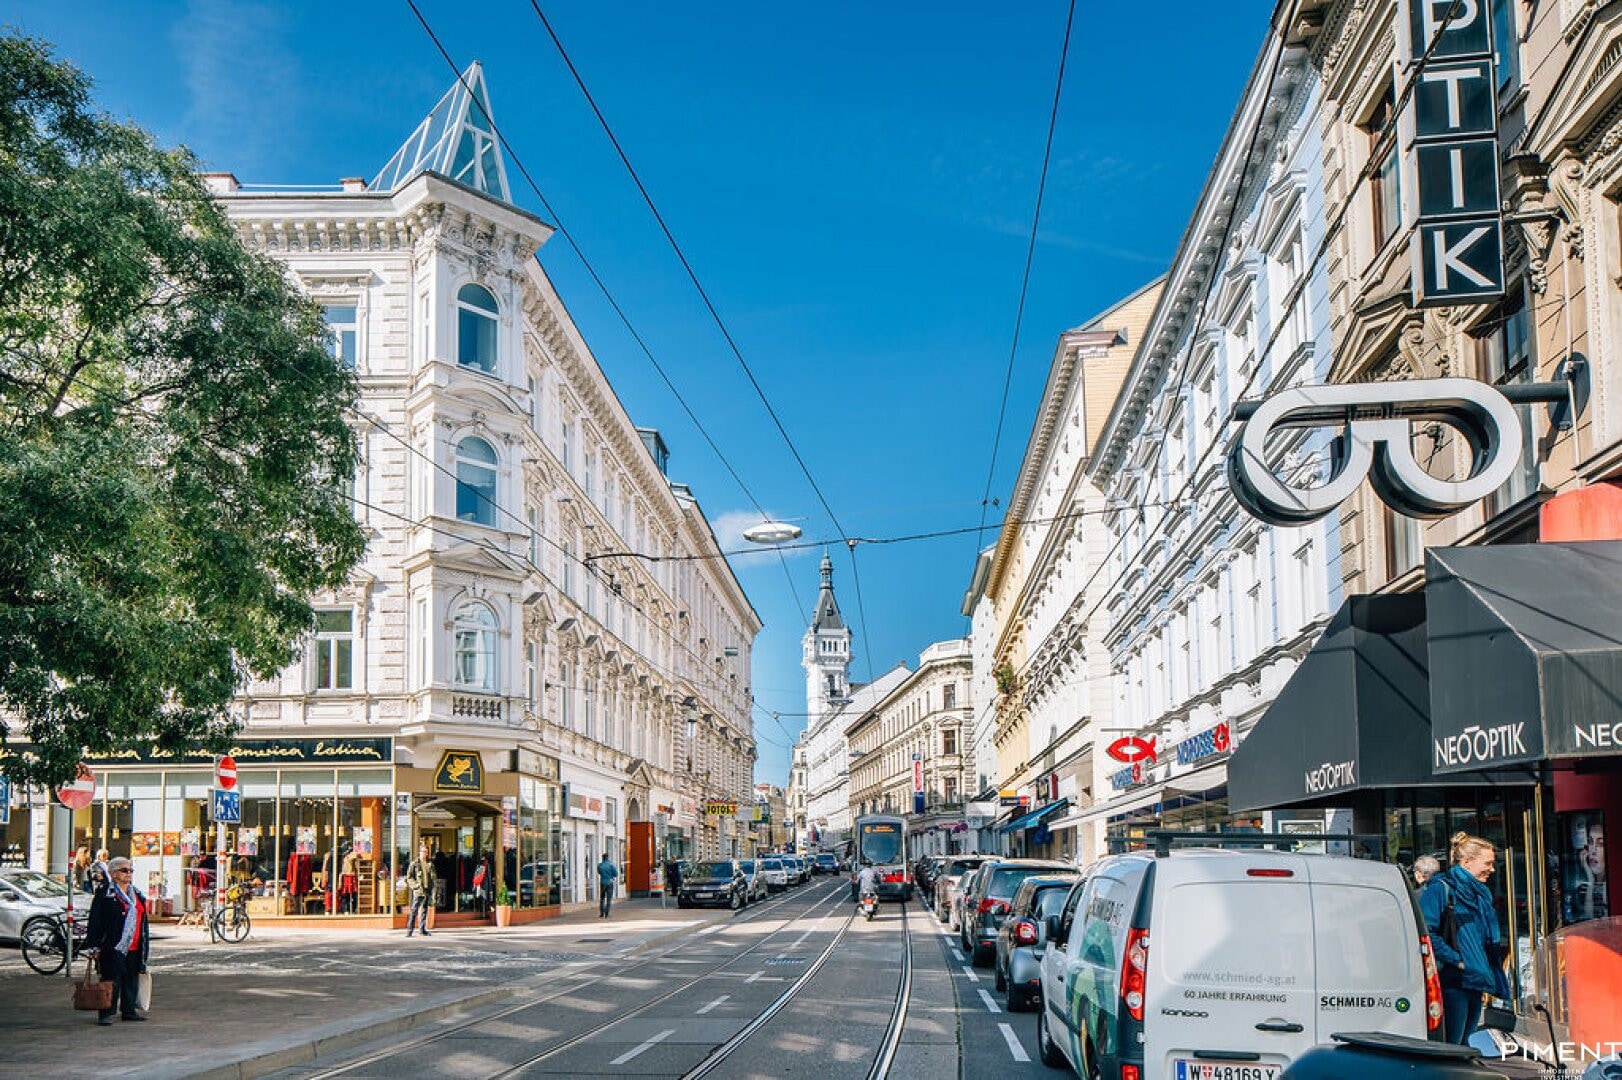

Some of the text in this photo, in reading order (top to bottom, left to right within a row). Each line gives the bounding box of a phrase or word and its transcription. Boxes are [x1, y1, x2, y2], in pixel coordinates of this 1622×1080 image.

[313, 742, 382, 760] latina
[1184, 989, 1287, 1003] 60 JAHRE ERFAHRUNG
[1320, 996, 1391, 1008] SCHMIED AG
[1190, 1065, 1201, 1080] W
